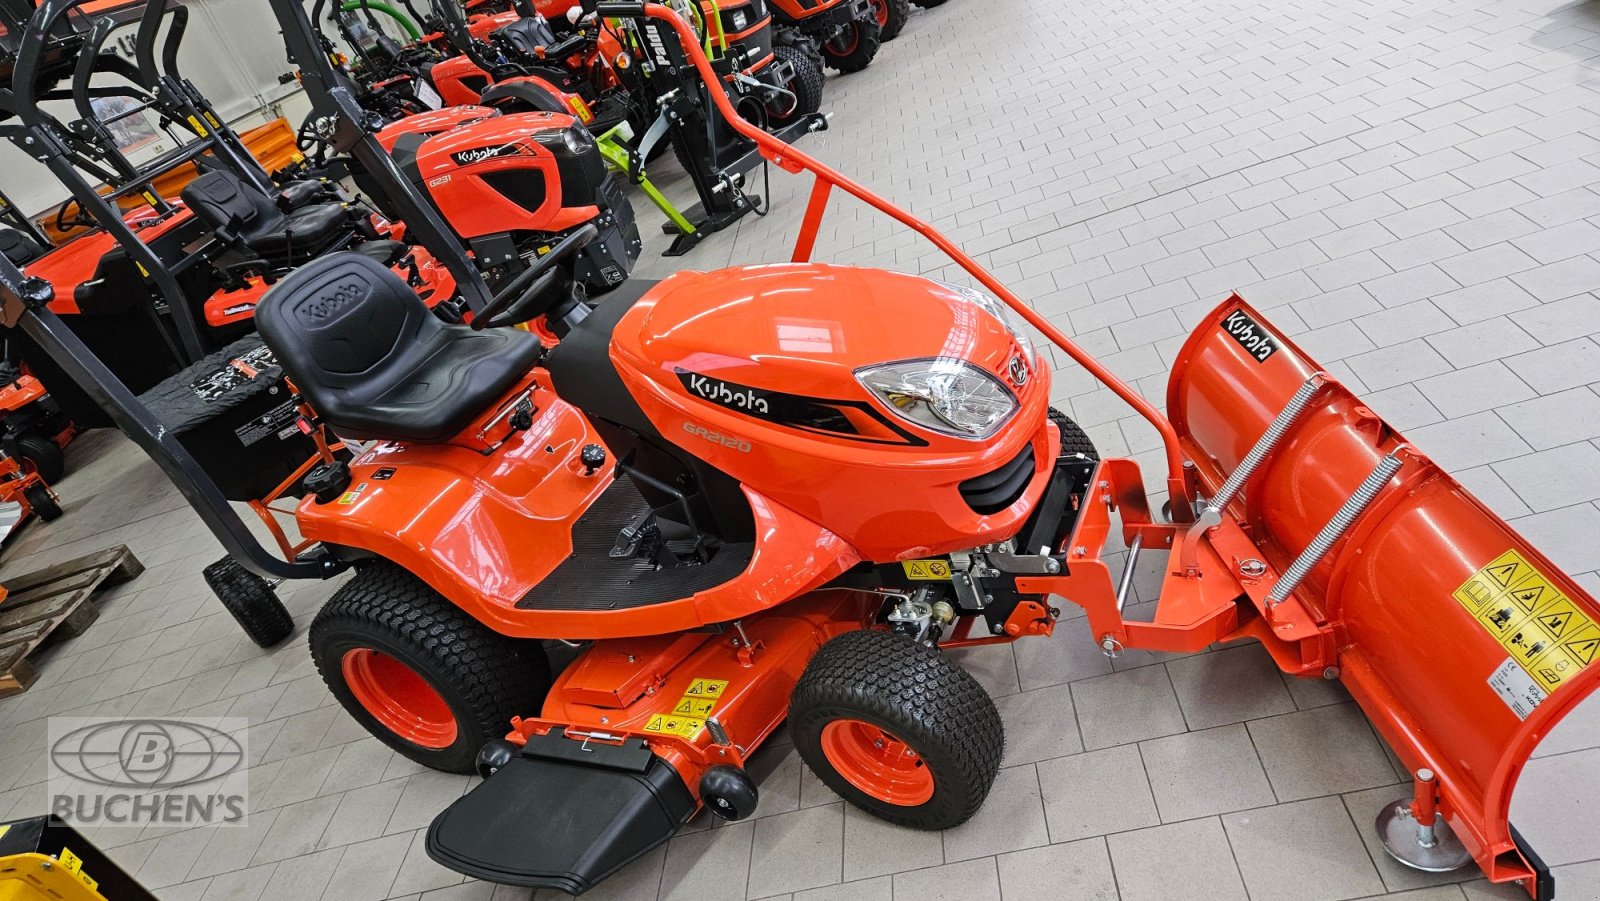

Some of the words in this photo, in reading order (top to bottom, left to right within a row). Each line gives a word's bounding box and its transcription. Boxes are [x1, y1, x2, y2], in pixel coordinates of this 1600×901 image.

[458, 147, 499, 162] Kubota
[429, 174, 452, 188] G231
[301, 284, 363, 322] Kubota
[1226, 310, 1272, 360] Kubota
[690, 374, 769, 414] Kubota
[682, 421, 752, 454] GR2120
